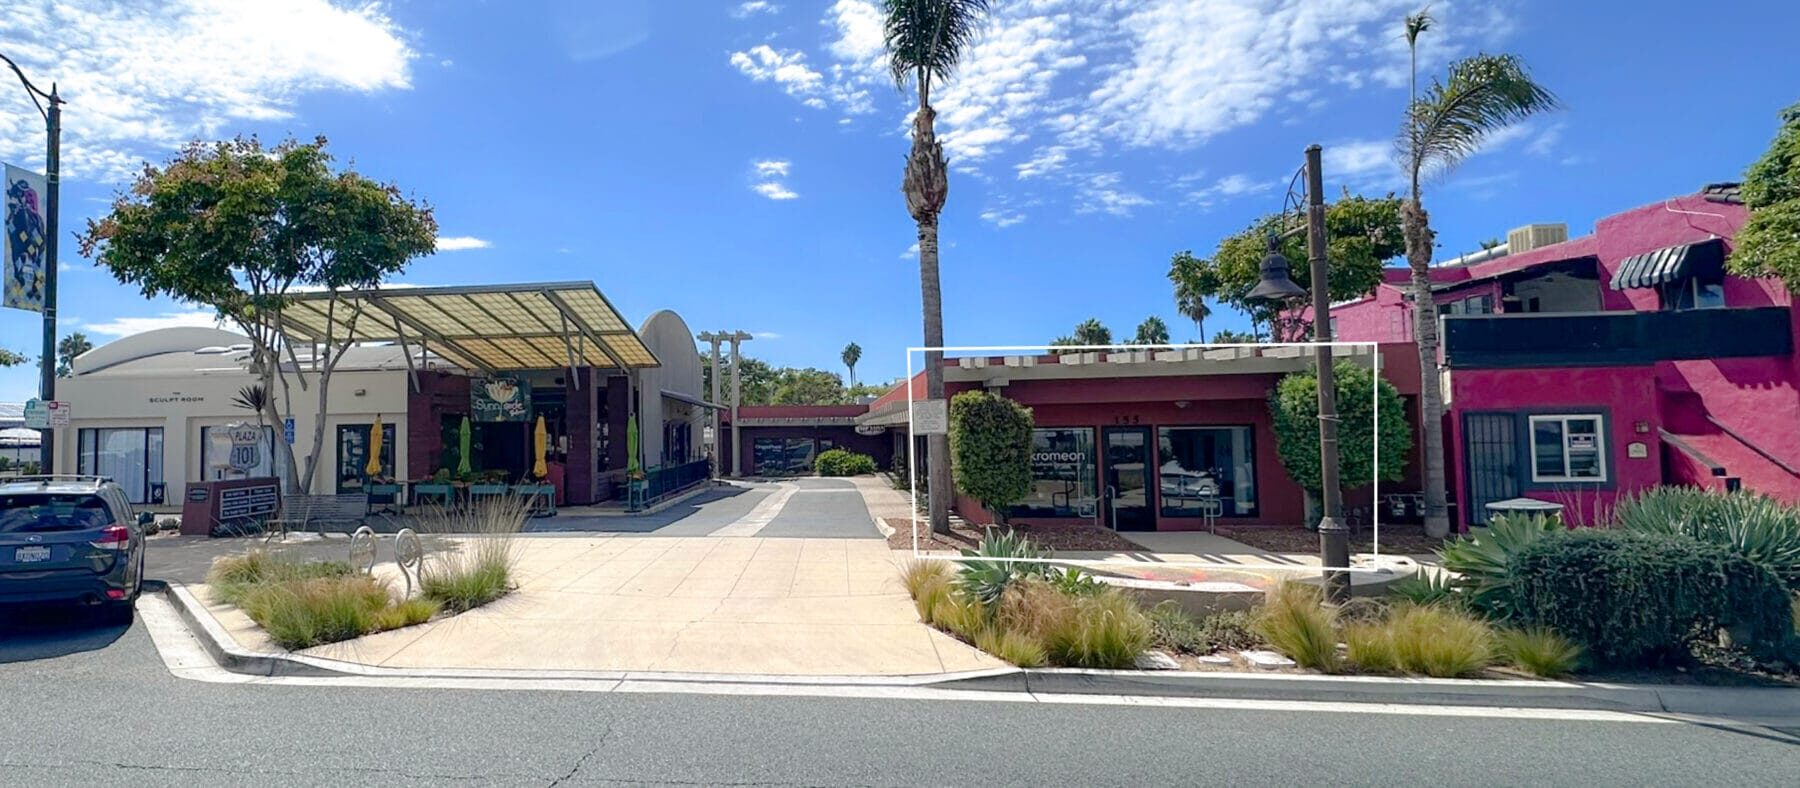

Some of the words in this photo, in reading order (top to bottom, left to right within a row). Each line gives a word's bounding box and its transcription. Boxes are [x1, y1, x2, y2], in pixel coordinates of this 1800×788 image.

[1115, 416, 1140, 424] 155
[235, 431, 256, 441] PLAZA
[236, 447, 254, 464] 101
